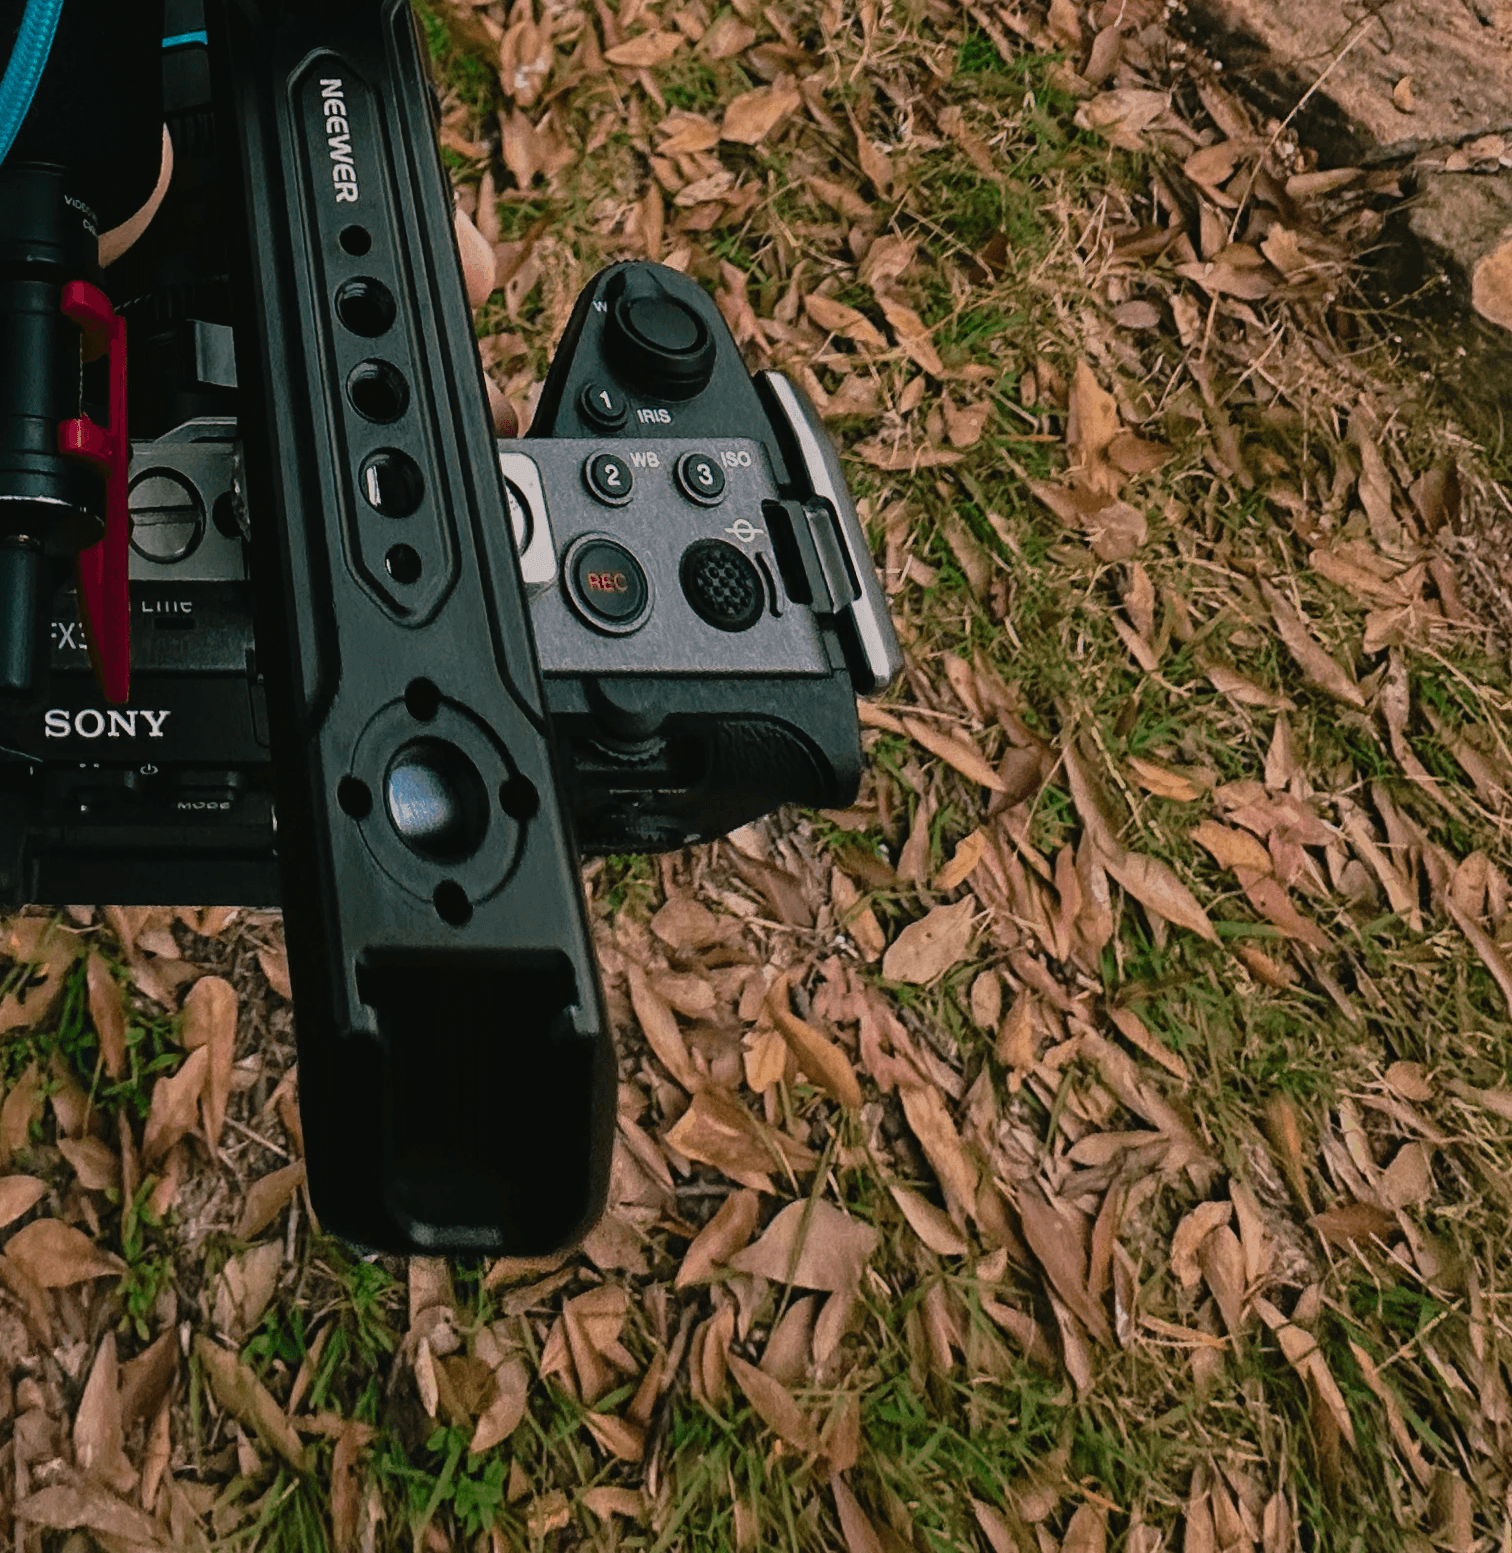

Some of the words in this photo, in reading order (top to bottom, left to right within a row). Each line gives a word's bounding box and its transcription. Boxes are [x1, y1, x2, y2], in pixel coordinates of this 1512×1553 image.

[319, 79, 359, 203] NEEWER
[599, 390, 612, 409] 1
[636, 408, 672, 424] IRIS
[630, 452, 660, 468] WB
[720, 451, 753, 467] ISO
[604, 464, 622, 486] 2
[696, 462, 714, 486] 3
[588, 572, 629, 592] REC
[44, 708, 171, 738] SONY
